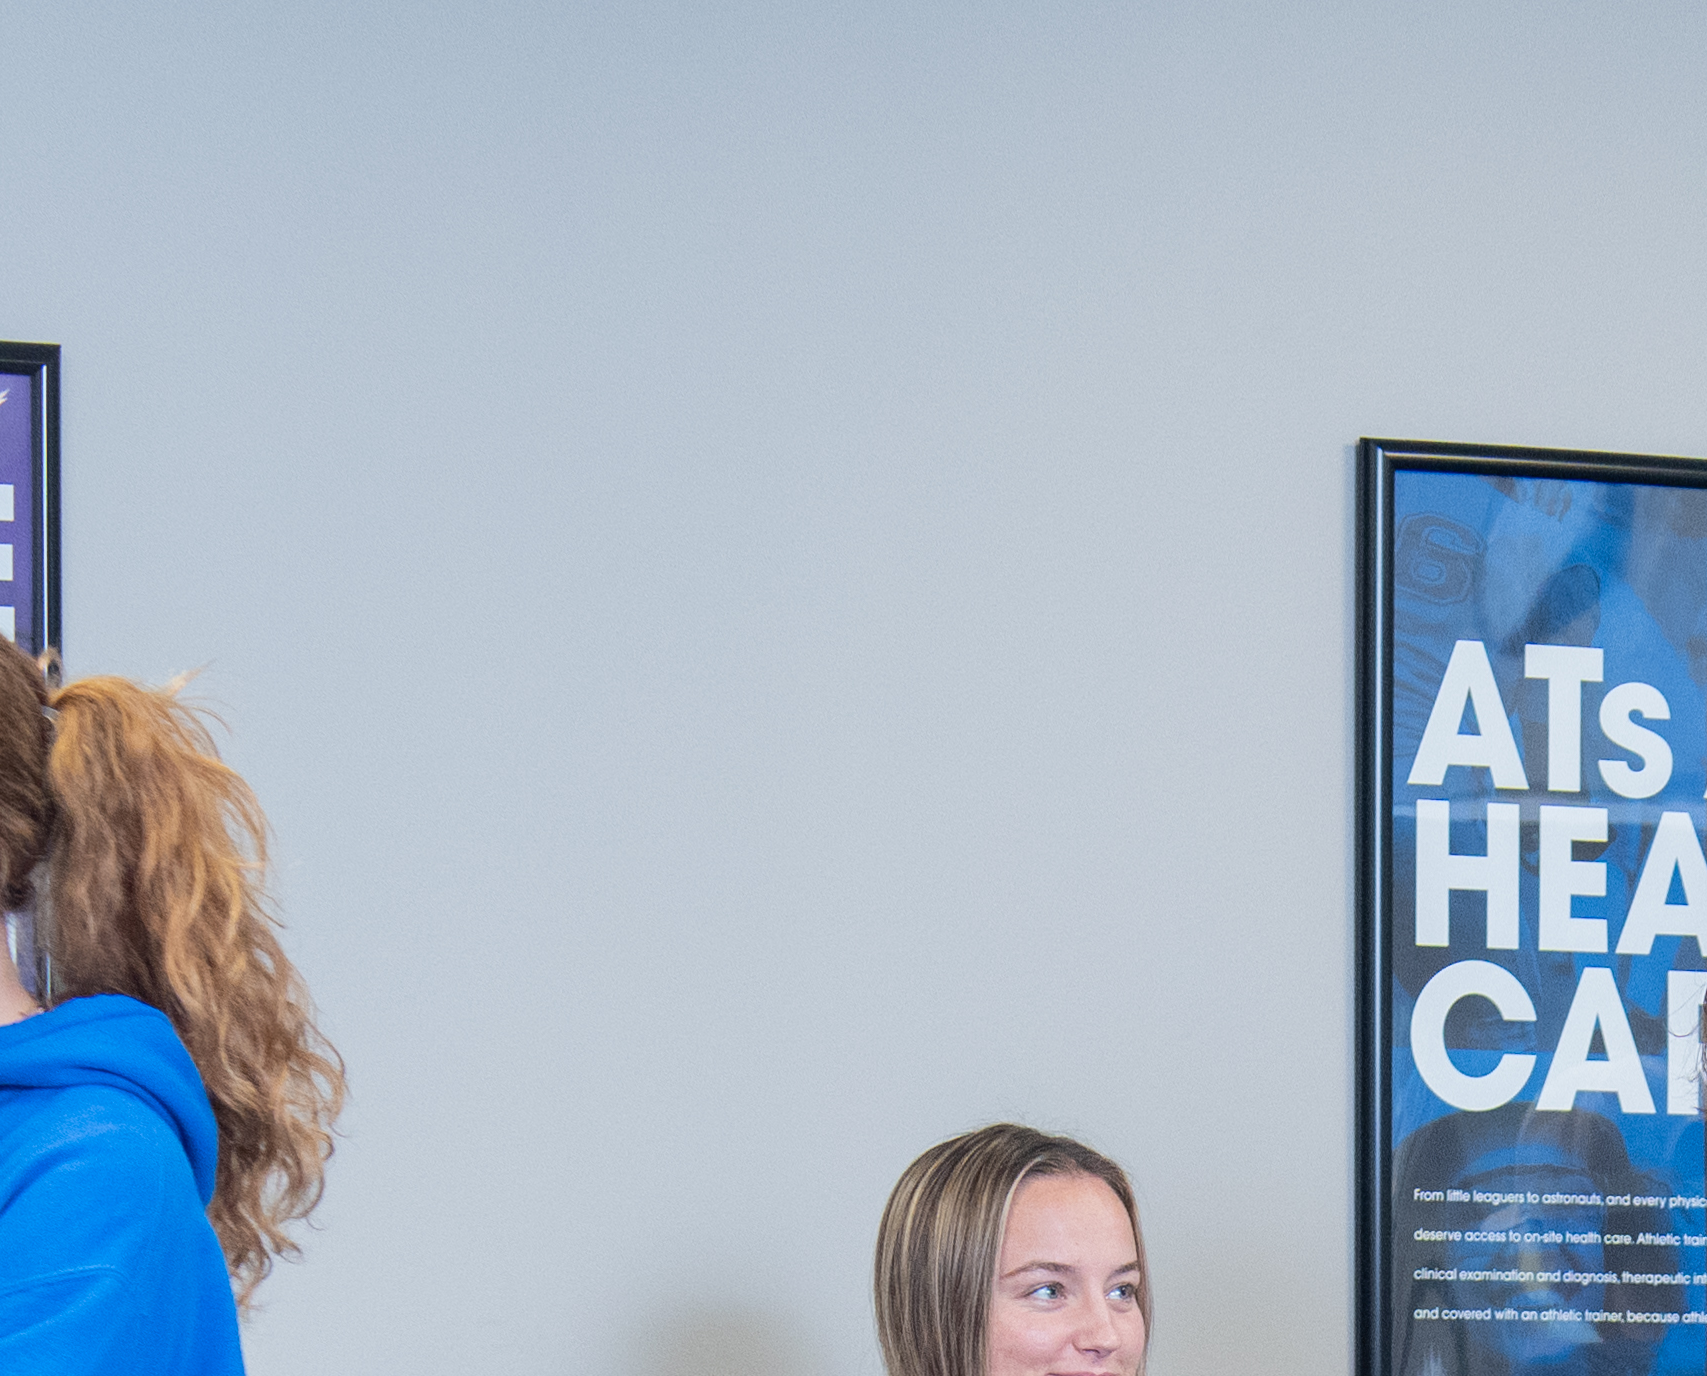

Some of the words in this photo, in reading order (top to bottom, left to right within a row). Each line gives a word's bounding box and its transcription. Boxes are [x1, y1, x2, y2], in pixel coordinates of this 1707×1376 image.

[1407, 639, 1673, 799] ATs
[1414, 1188, 1444, 1201] From
[1447, 1189, 1470, 1202] little
[1473, 1189, 1524, 1205] leaguers
[1526, 1191, 1539, 1203] to
[1542, 1192, 1604, 1205] astronauts,
[1606, 1194, 1630, 1205] and
[1633, 1196, 1666, 1209] every
[1414, 1228, 1461, 1241] deserve
[1464, 1231, 1506, 1242] access
[1509, 1230, 1521, 1242] to
[1523, 1231, 1563, 1243] on-site
[1565, 1231, 1601, 1243] health
[1604, 1233, 1634, 1244] care.
[1636, 1233, 1680, 1246] Athletic
[1413, 1267, 1457, 1280] clinical
[1458, 1269, 1534, 1282] examination
[1536, 1270, 1560, 1282] and
[1562, 1270, 1620, 1286] diagnosis,
[1621, 1271, 1691, 1287] therapeutic
[1413, 1307, 1439, 1320] and
[1441, 1308, 1492, 1320] covered
[1494, 1308, 1518, 1321] with
[1521, 1310, 1538, 1321] an
[1540, 1309, 1582, 1322] athletic
[1585, 1309, 1625, 1323] trainer,
[1627, 1310, 1680, 1323] because
